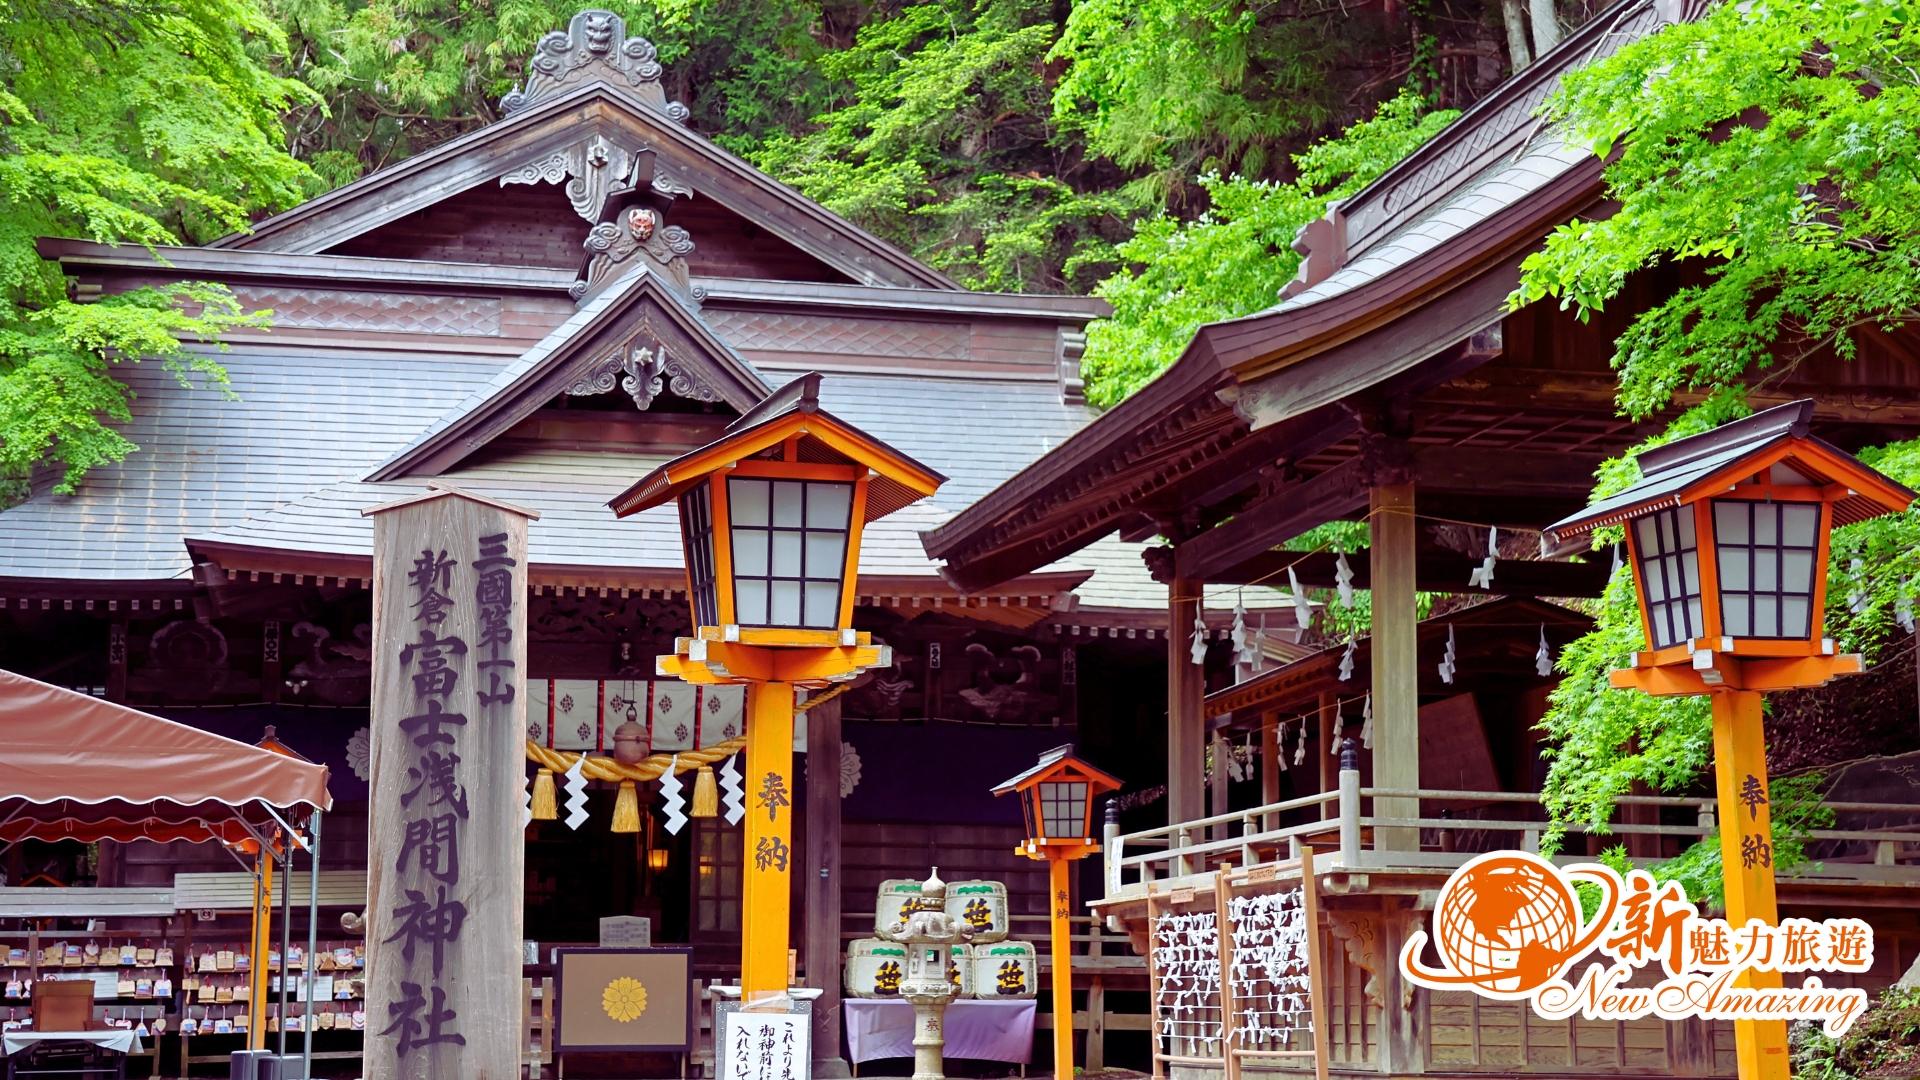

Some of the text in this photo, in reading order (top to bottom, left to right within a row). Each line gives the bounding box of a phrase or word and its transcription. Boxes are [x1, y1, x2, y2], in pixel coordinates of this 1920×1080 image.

[472, 532, 517, 707] 三國第一山
[377, 550, 469, 1058] 新倉富士浅間神社
[755, 771, 790, 873] 奉納
[1739, 774, 1772, 870] 奉納
